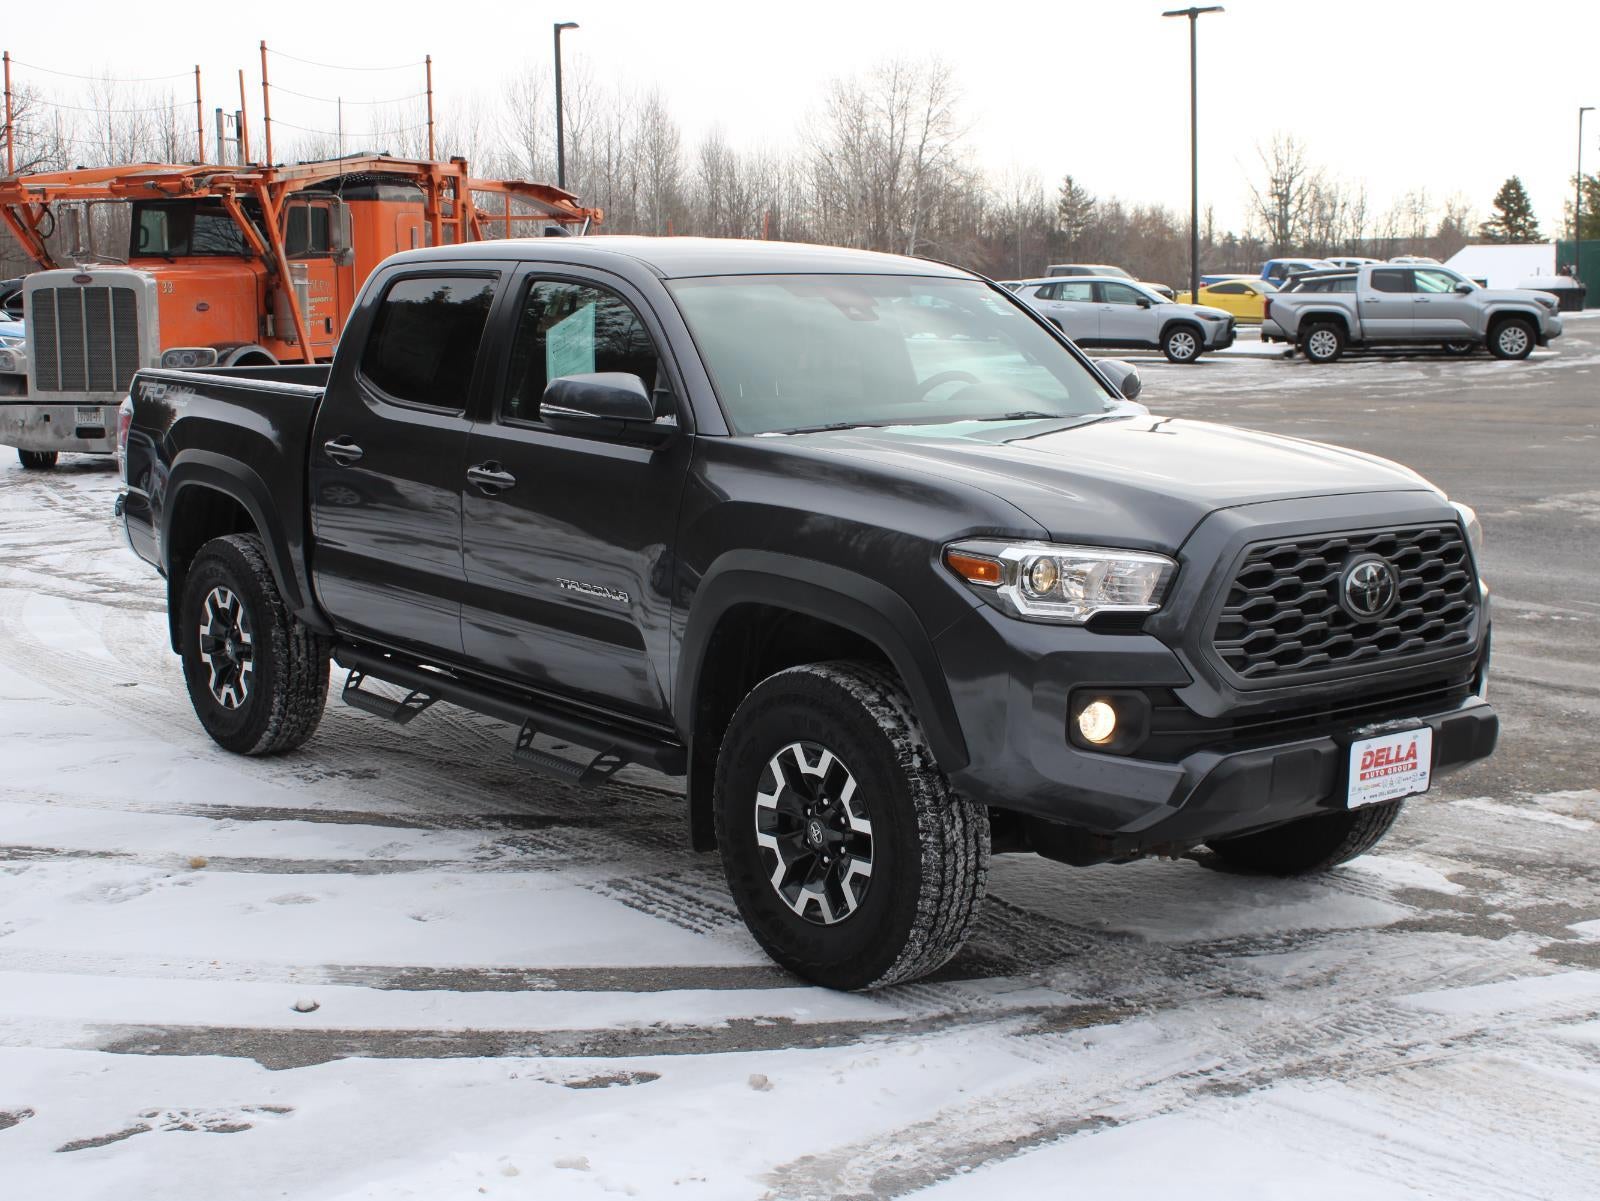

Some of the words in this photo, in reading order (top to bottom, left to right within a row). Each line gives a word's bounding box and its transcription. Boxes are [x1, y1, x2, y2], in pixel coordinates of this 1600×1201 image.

[139, 381, 167, 402] TRD
[556, 577, 629, 603] TACOMA
[1360, 741, 1417, 770] DELLA
[1365, 770, 1385, 779] AUTO
[1387, 763, 1413, 774] GROUP
